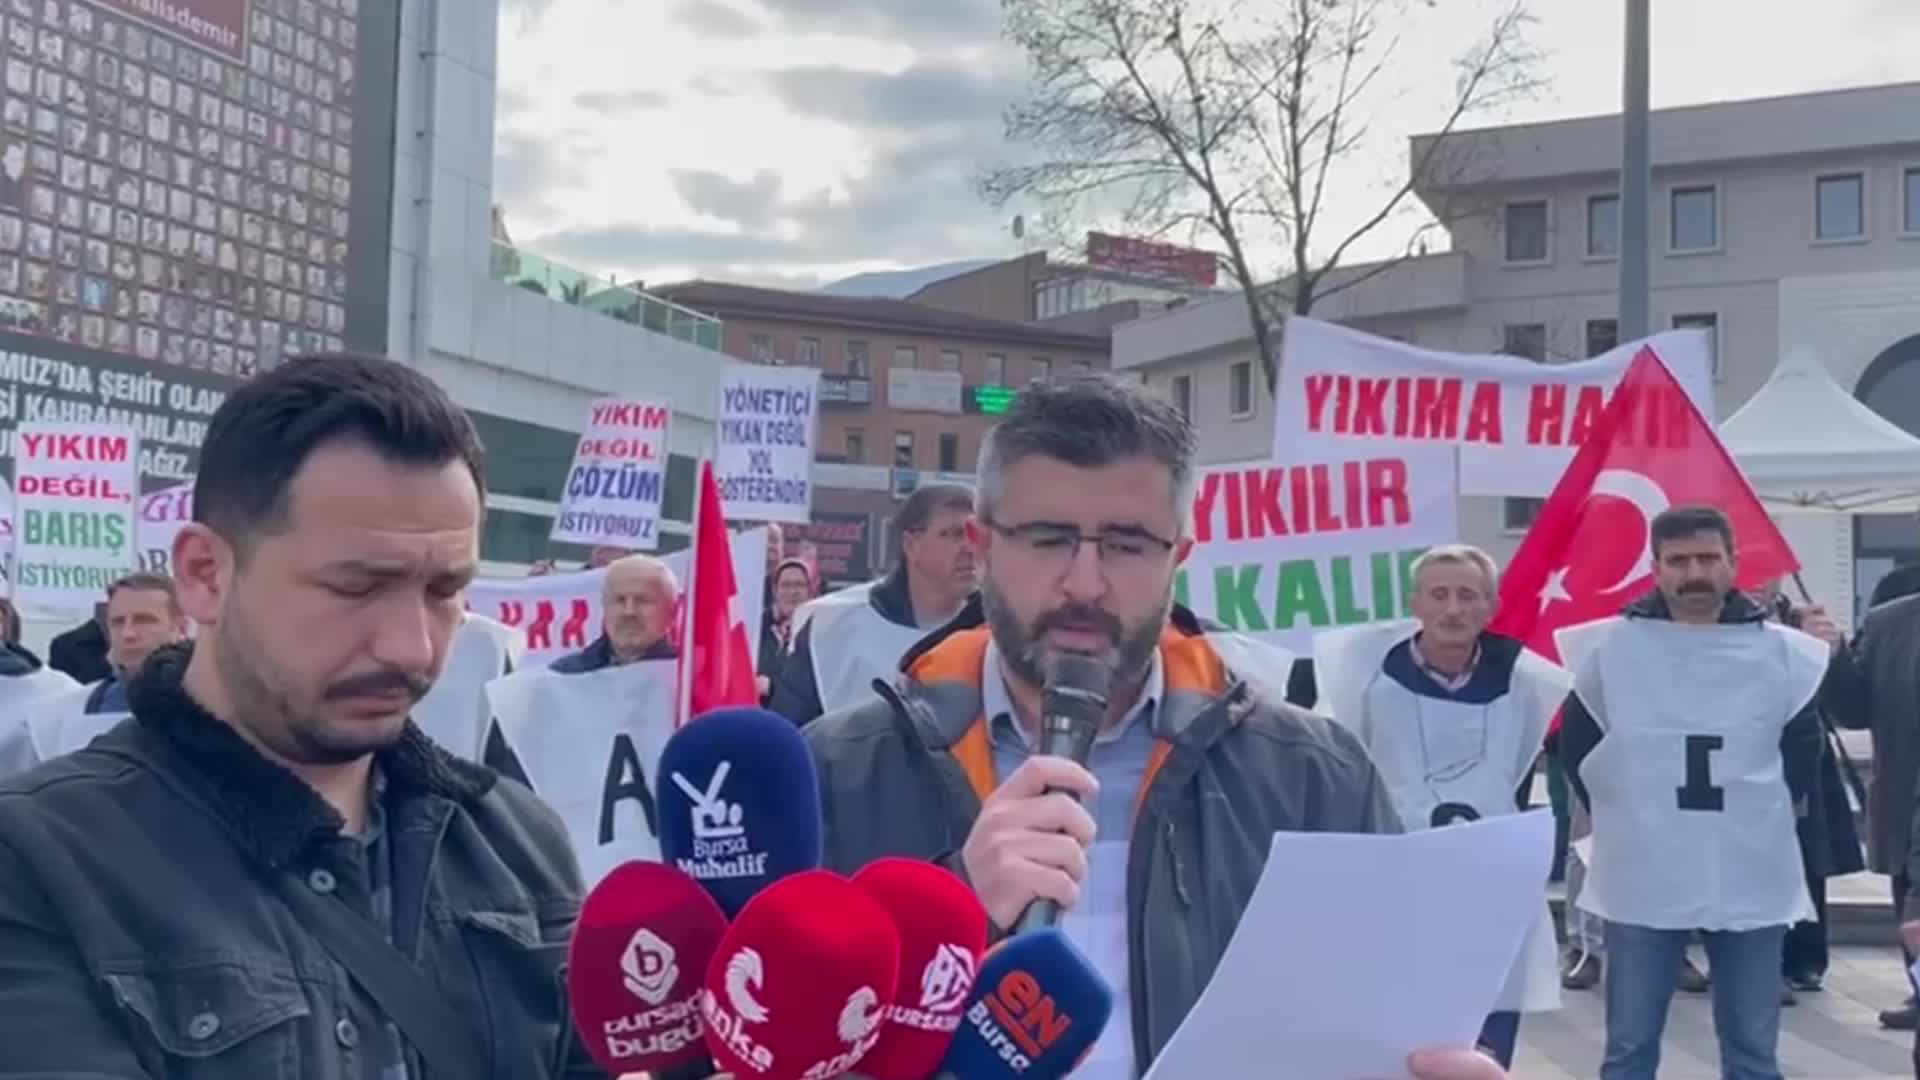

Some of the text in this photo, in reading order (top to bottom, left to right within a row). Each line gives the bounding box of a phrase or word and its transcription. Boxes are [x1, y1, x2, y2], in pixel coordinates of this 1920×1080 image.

[98, 369, 165, 405] ŞEHİT
[724, 381, 811, 417] YÖNETİCİ
[592, 404, 667, 429] YIKIM
[1305, 375, 1503, 444] YIKIMA
[22, 433, 128, 461] YIKIM
[1193, 458, 1412, 543] YIKILIR
[24, 510, 124, 556] BARIŞ
[598, 733, 657, 846] A
[694, 837, 748, 858] Bursa
[966, 1000, 1031, 1074] Bursa
